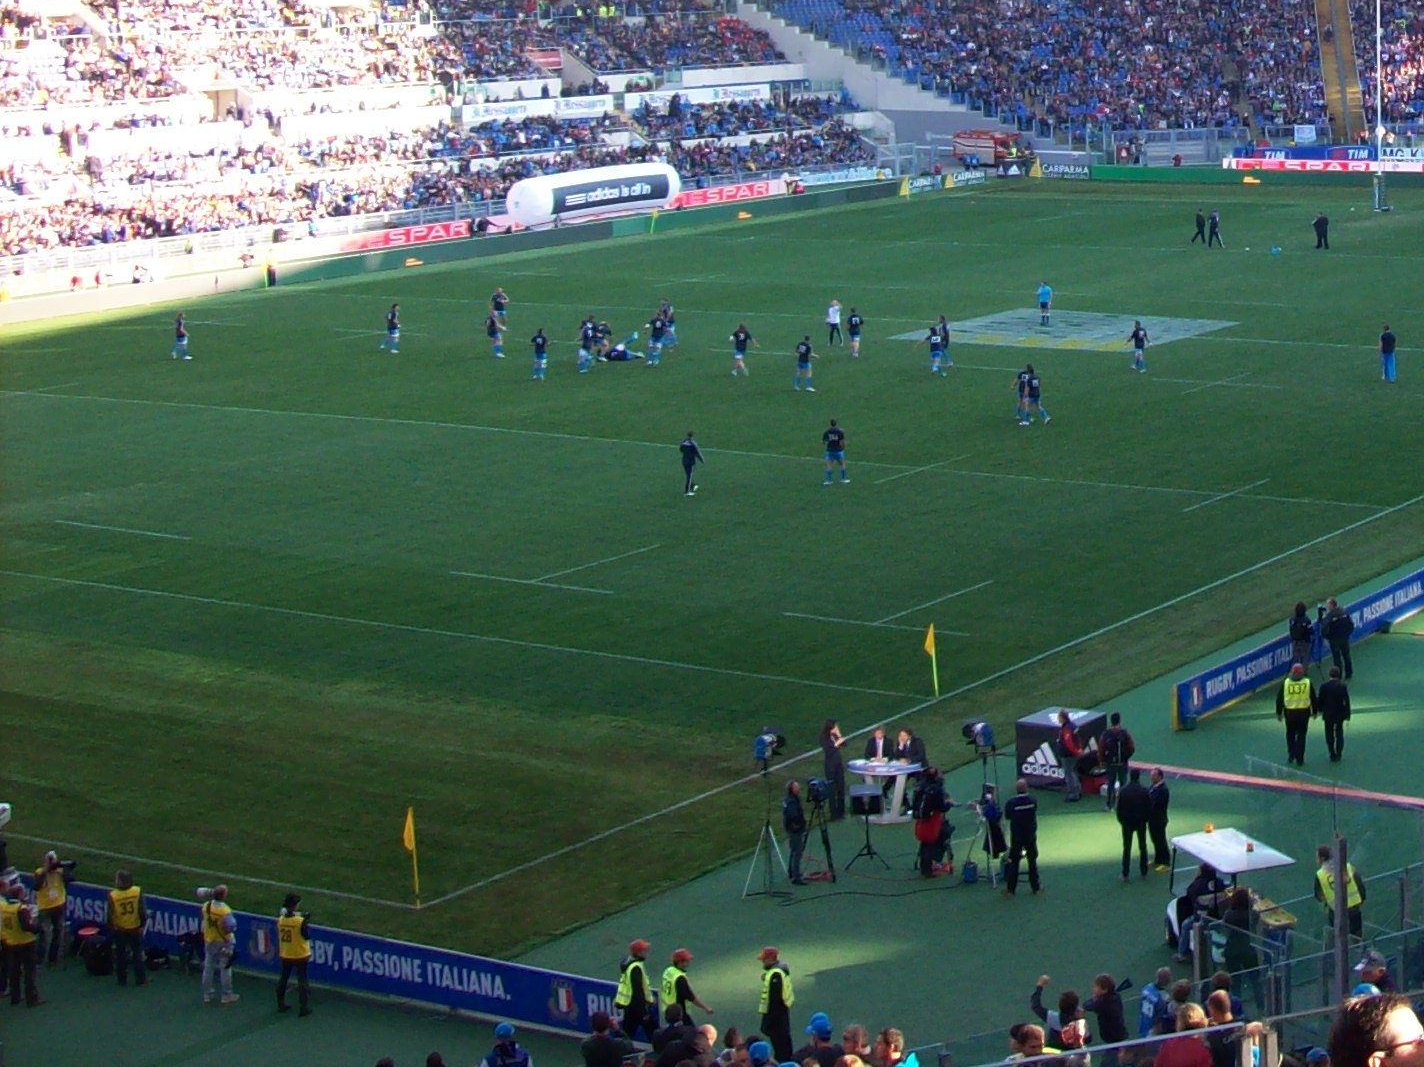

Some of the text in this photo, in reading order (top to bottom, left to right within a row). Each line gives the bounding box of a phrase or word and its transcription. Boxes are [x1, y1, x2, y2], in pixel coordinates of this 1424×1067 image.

[1265, 151, 1285, 160] TIM
[1348, 150, 1368, 159] TIM
[587, 186, 619, 202] adidas
[620, 184, 629, 198] is
[1206, 642, 1295, 700] RUGBY, PASSIONE ITALI
[1022, 763, 1066, 779] adidas
[66, 895, 109, 922] PASSI
[120, 900, 135, 917] 33
[342, 946, 423, 983] PASSIONE
[427, 961, 512, 1001] ITALIANA.
